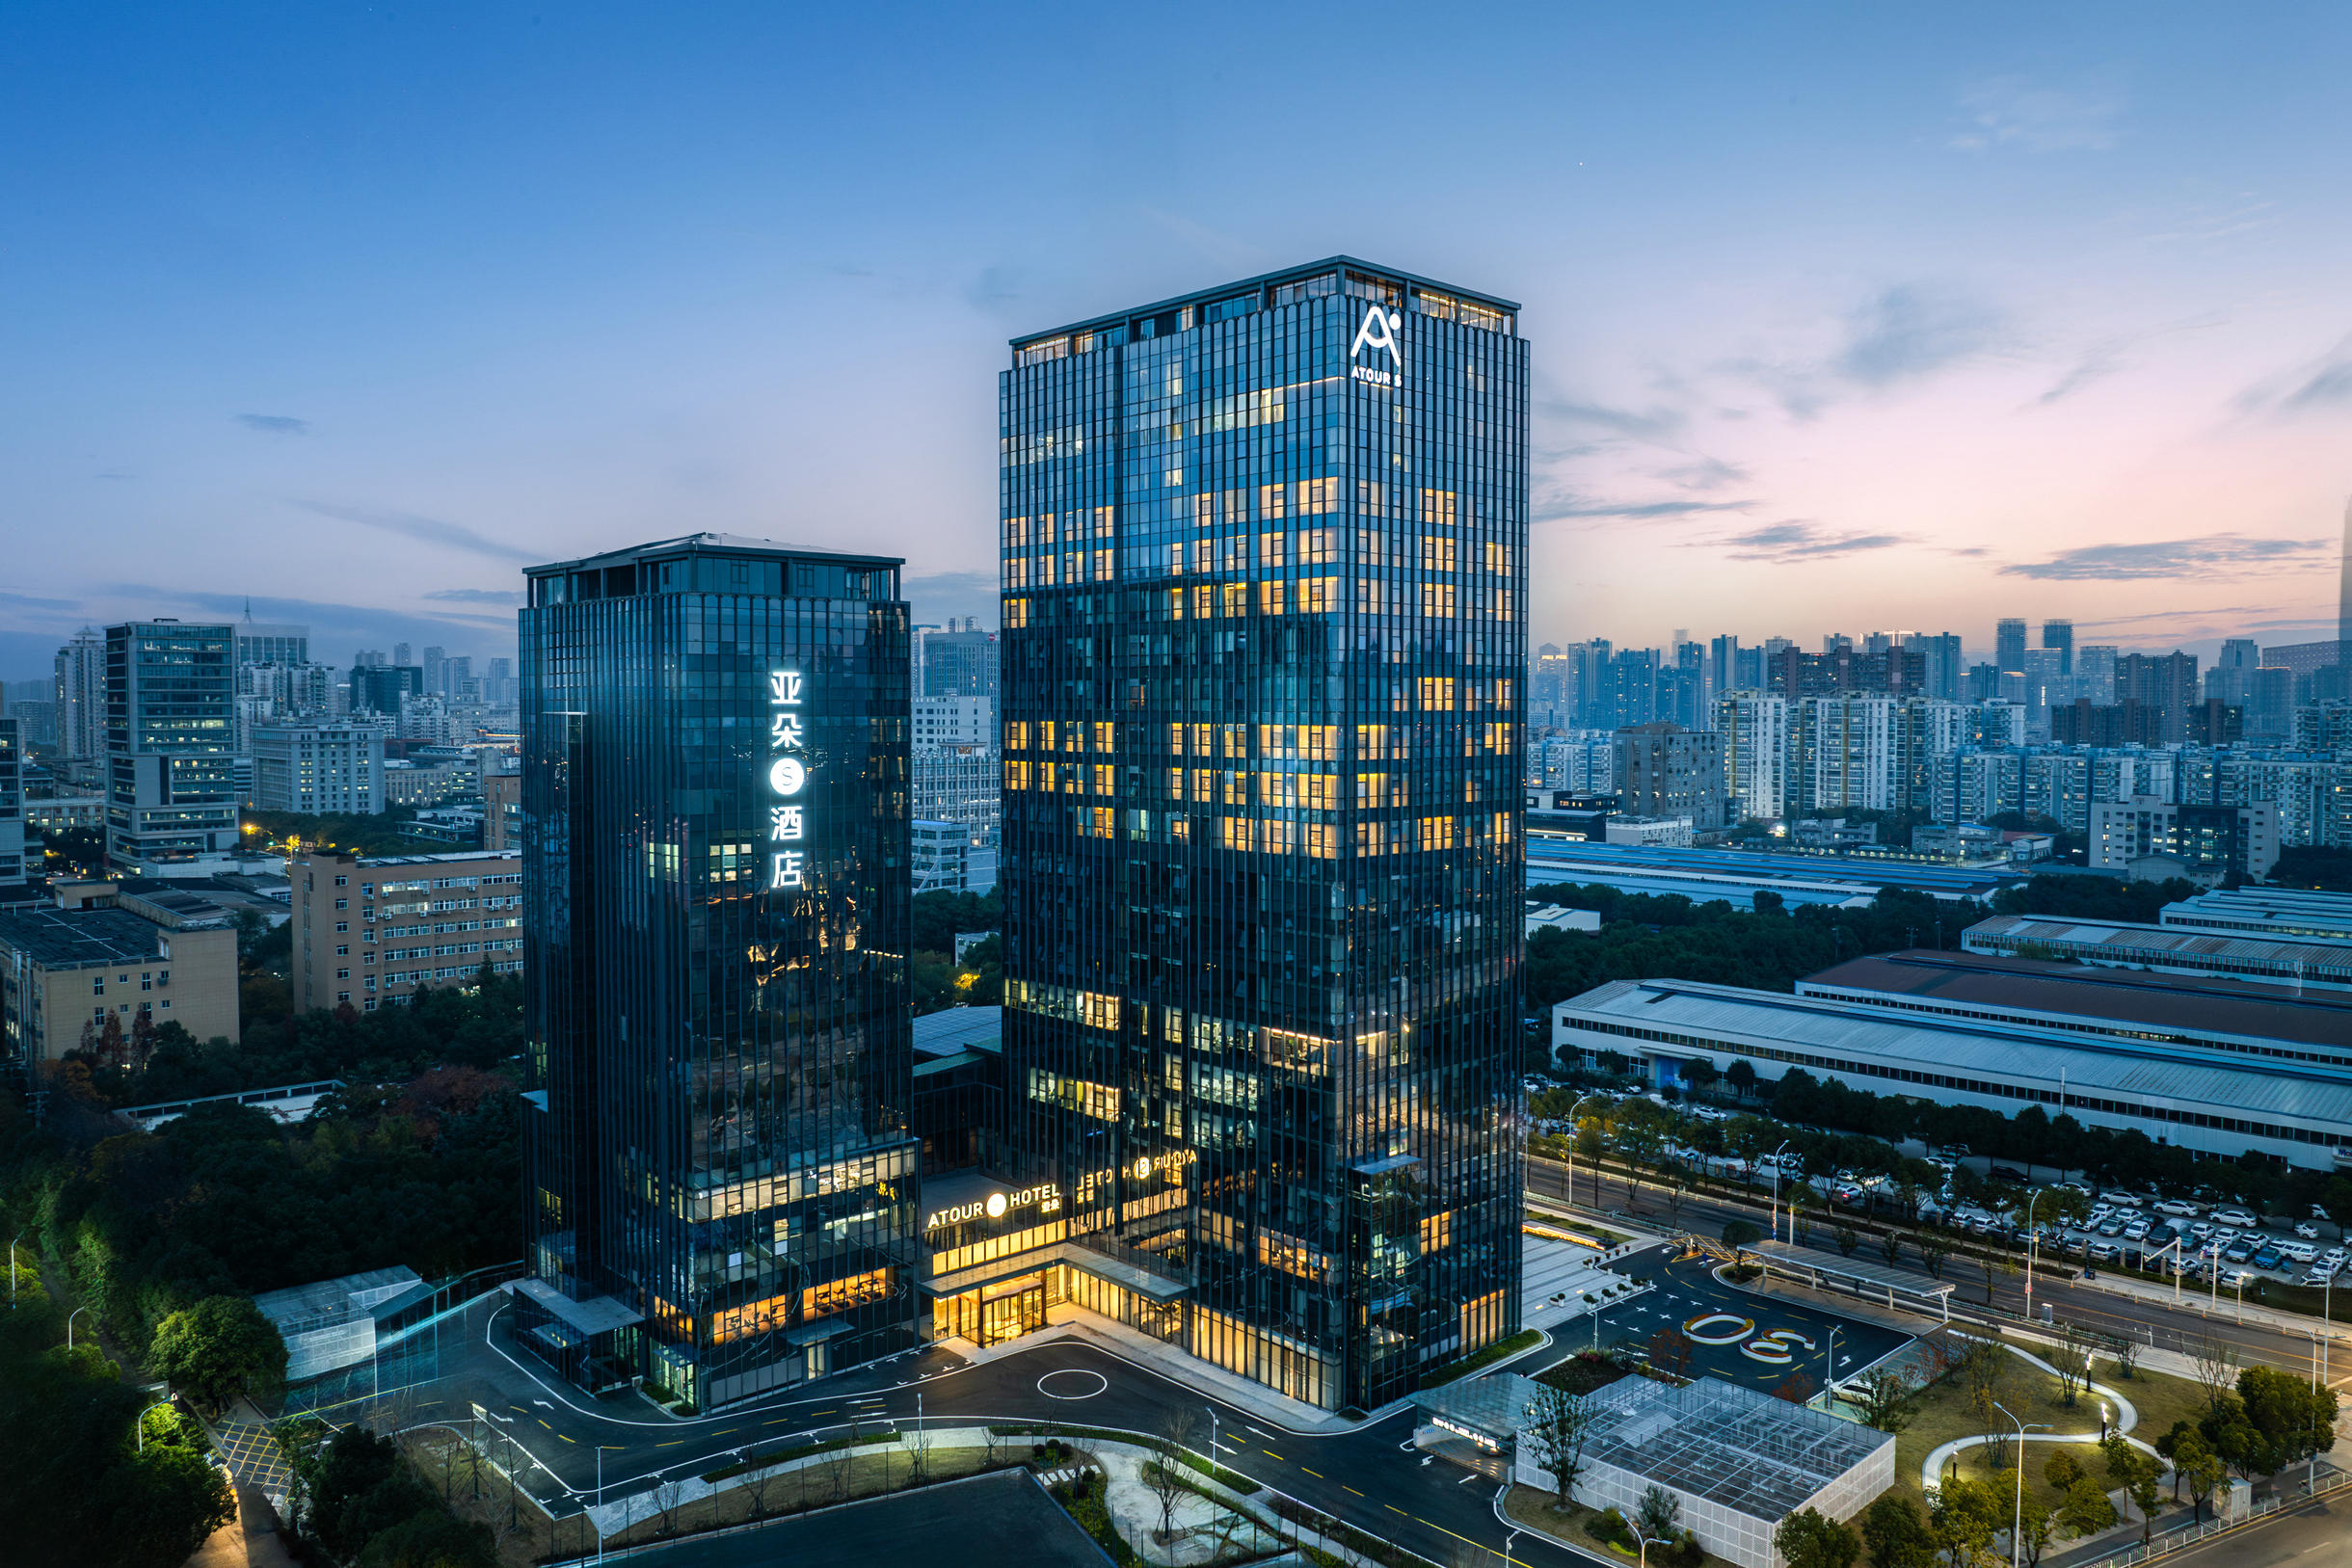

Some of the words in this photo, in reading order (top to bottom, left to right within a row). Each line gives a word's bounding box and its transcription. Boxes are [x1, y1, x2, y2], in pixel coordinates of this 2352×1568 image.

[1351, 366, 1391, 385] ATOUR
[1394, 374, 1403, 387] S
[927, 1202, 983, 1229] ATOUR
[1009, 1183, 1060, 1208] HOTEL
